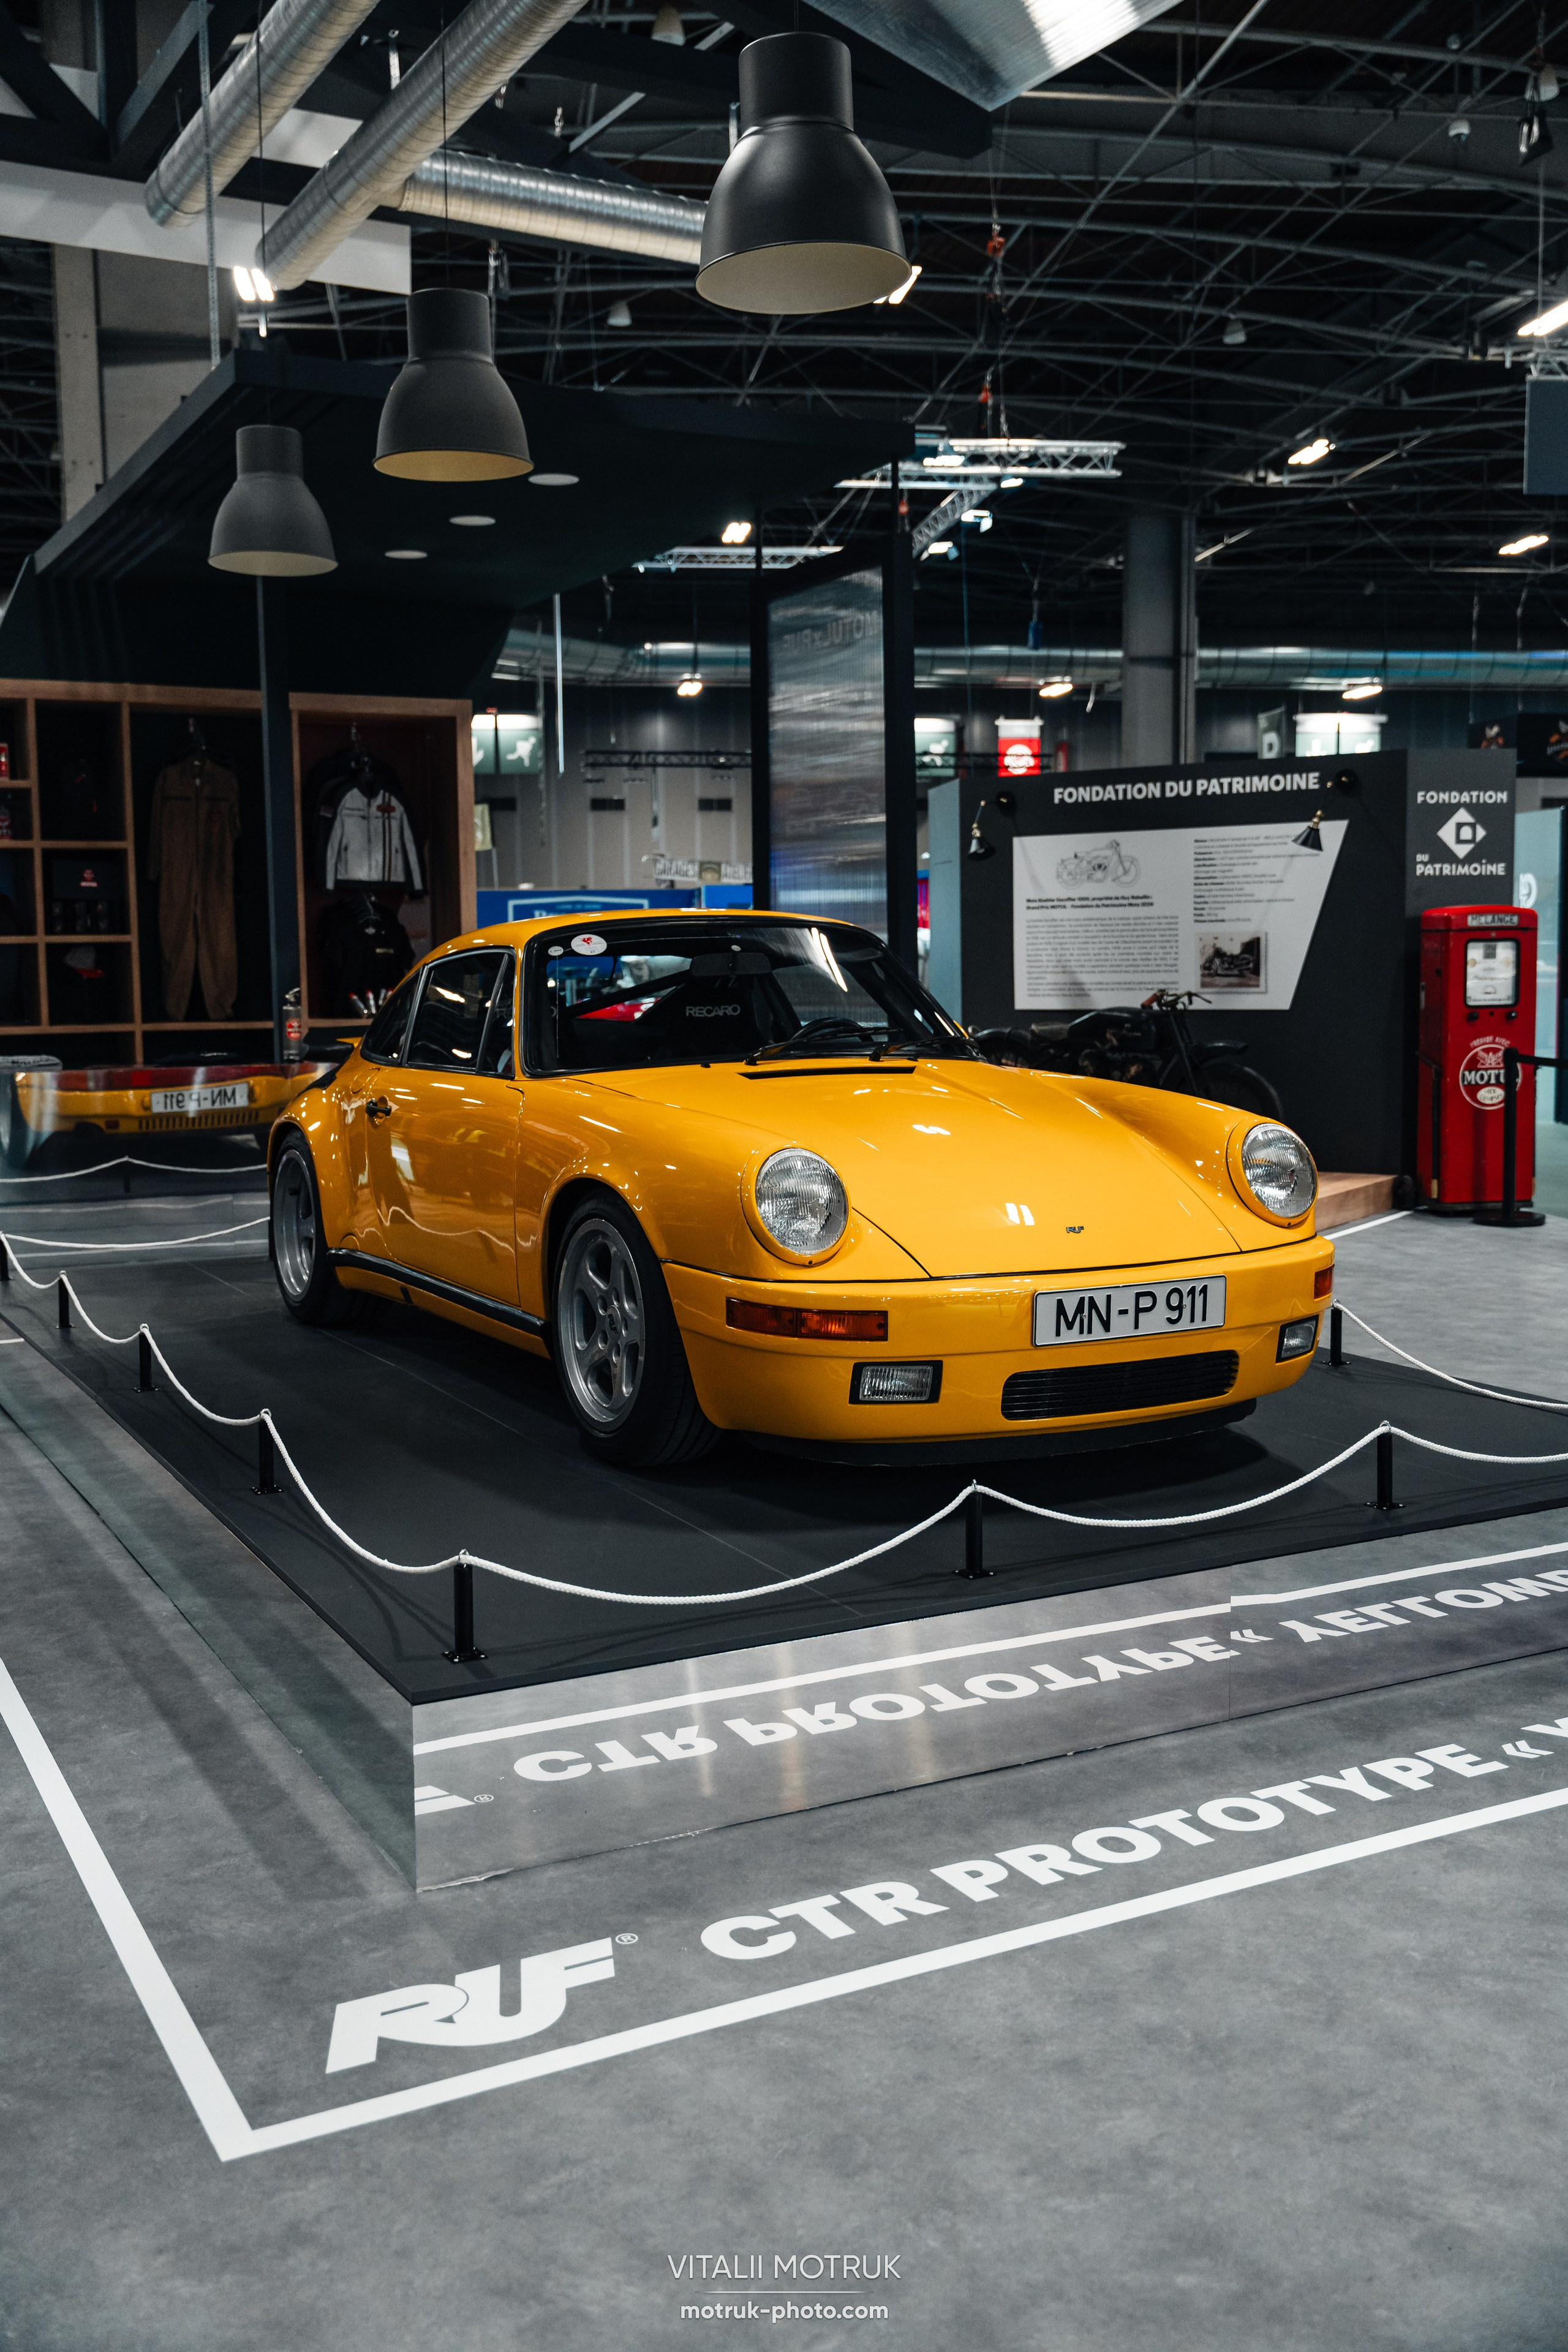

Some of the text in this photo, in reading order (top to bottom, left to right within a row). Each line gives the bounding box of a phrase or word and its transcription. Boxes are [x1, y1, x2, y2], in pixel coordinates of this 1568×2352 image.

[1054, 772, 1321, 804] FONDATION DU PATRIMOINE
[1417, 790, 1508, 804] FONDATION
[1415, 853, 1430, 862] DU
[685, 1004, 741, 1017] RECARO
[1463, 1069, 1519, 1085] MOT
[1055, 1284, 1208, 1336] MN-P 911
[700, 1881, 950, 1960] CTR
[929, 1743, 1509, 1902] PROTOTYPE
